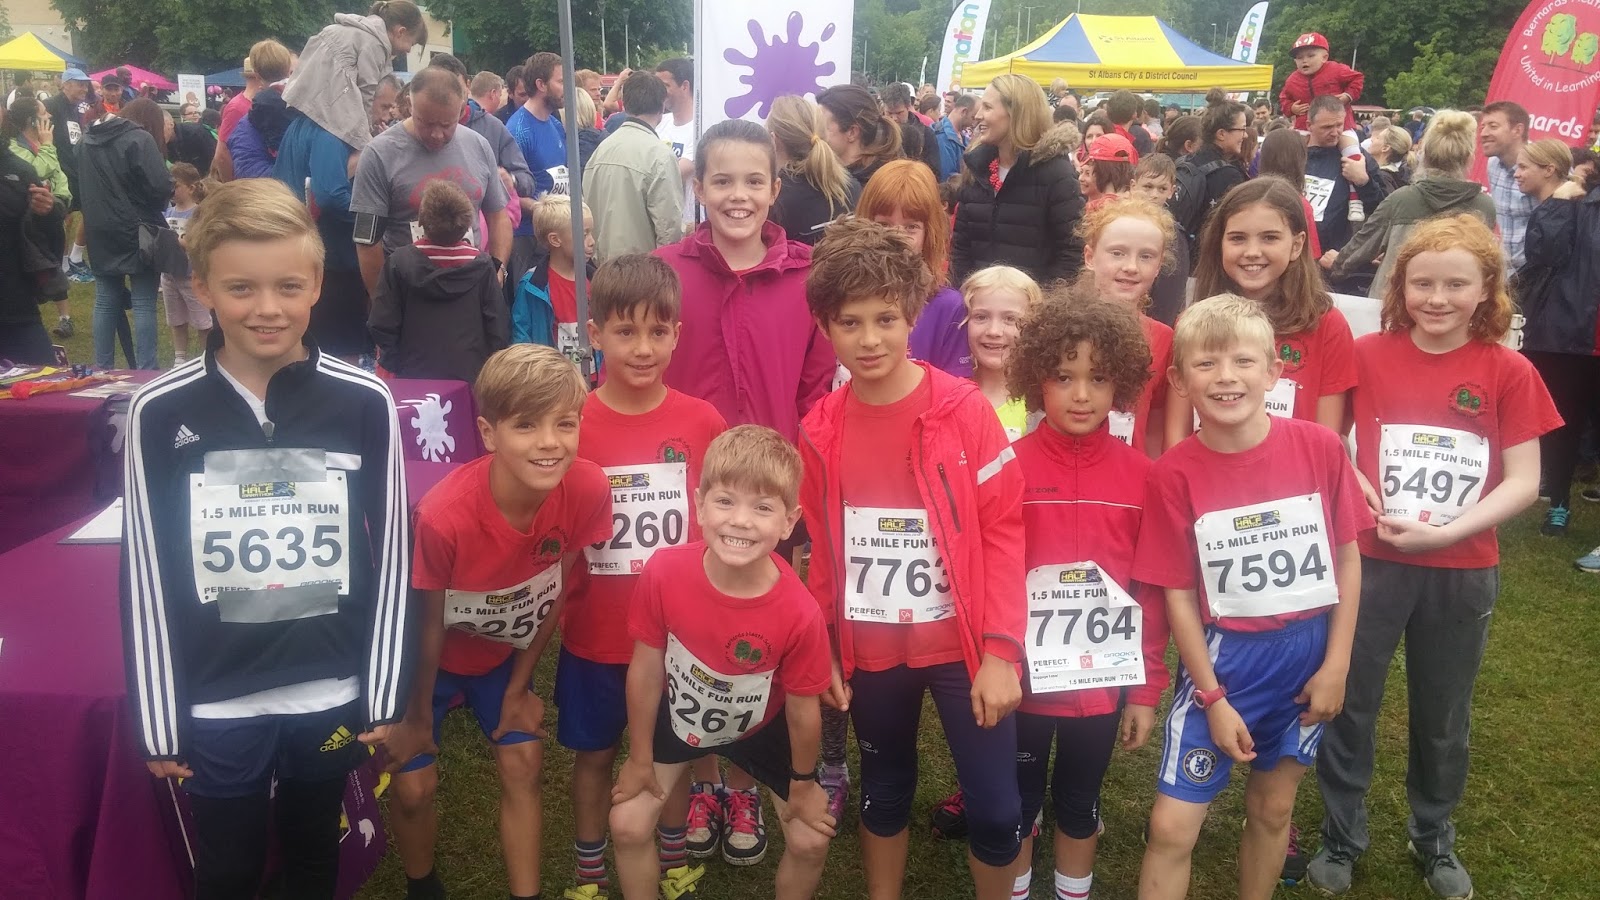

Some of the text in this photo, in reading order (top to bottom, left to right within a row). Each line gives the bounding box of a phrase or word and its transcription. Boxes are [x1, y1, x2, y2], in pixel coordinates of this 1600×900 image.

[1523, 0, 1568, 37] Bernards
[1240, 13, 1260, 62] ation
[1089, 70, 1198, 81] St Albans City & District Council
[1520, 55, 1545, 87] United
[1543, 80, 1553, 91] in
[1265, 401, 1288, 411] RUN
[175, 434, 200, 449] adidas
[1384, 449, 1482, 468] 1.5 MILE FUN RUN
[612, 490, 681, 503] LE FUN RUN
[1383, 465, 1481, 507] 5497
[201, 503, 340, 519] 1.5 MILE FUN RUN
[591, 509, 683, 550] 260
[851, 537, 867, 546] 1.5
[870, 537, 899, 548] MILE
[903, 538, 928, 548] FUN
[1205, 540, 1225, 551] 1.5
[1228, 534, 1259, 548] MILE
[1262, 529, 1288, 542] FUN
[1292, 523, 1319, 537] RUN
[202, 525, 342, 573] 5635
[850, 556, 951, 597] 7763
[1207, 543, 1327, 594] 7594
[453, 581, 557, 615] 1.5 MILE FUN RUN
[1031, 588, 1108, 600] 1.5 MILE FUN
[849, 607, 888, 616] PERFECT.
[1030, 606, 1136, 647] 7764
[670, 656, 762, 704] 1.5 MILE FUN RUN
[1119, 673, 1138, 681] 7764
[320, 733, 356, 752] adidas
